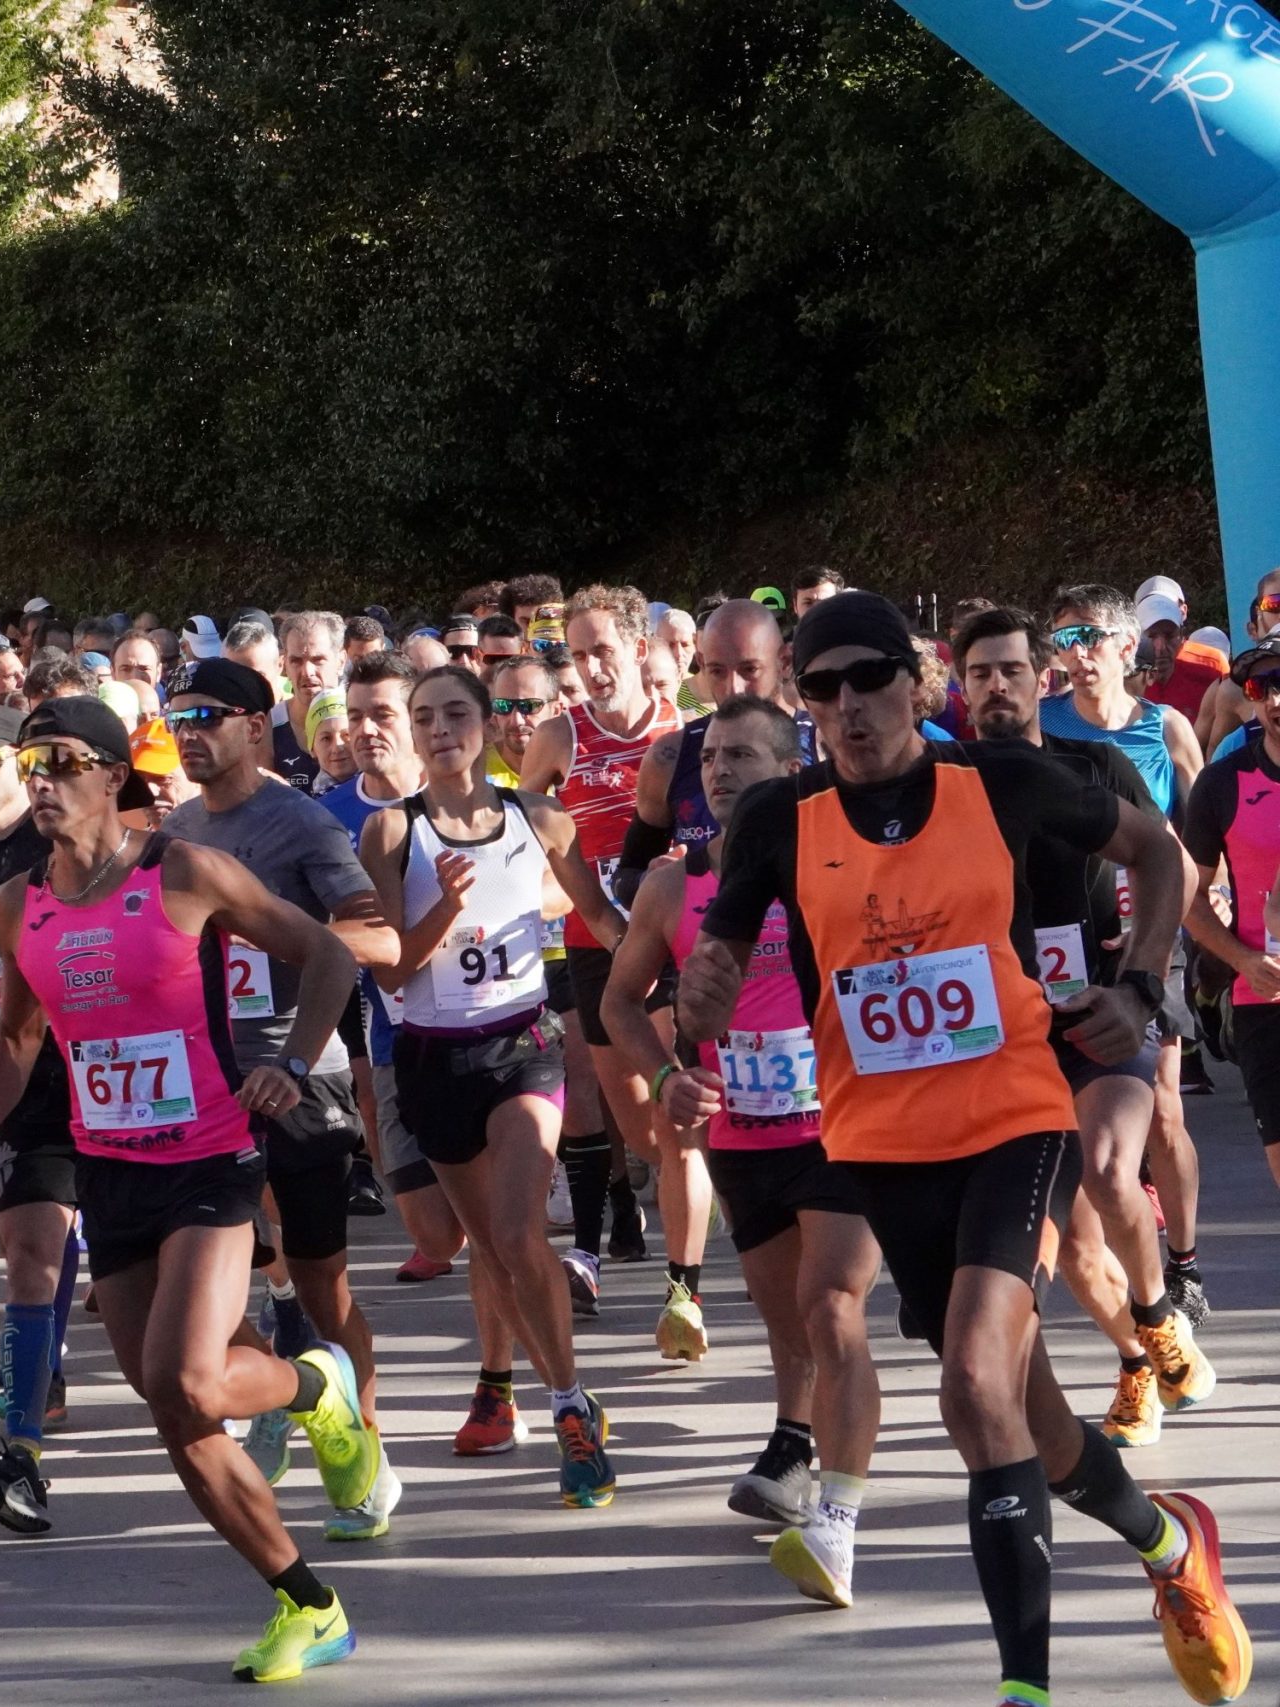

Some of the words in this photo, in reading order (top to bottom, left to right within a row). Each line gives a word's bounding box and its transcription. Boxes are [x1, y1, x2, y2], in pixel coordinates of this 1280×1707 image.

[60, 967, 114, 989] Tesar
[460, 944, 516, 985] 91
[859, 979, 975, 1044] 609
[86, 1056, 169, 1105] 677
[724, 1050, 816, 1093] 1137
